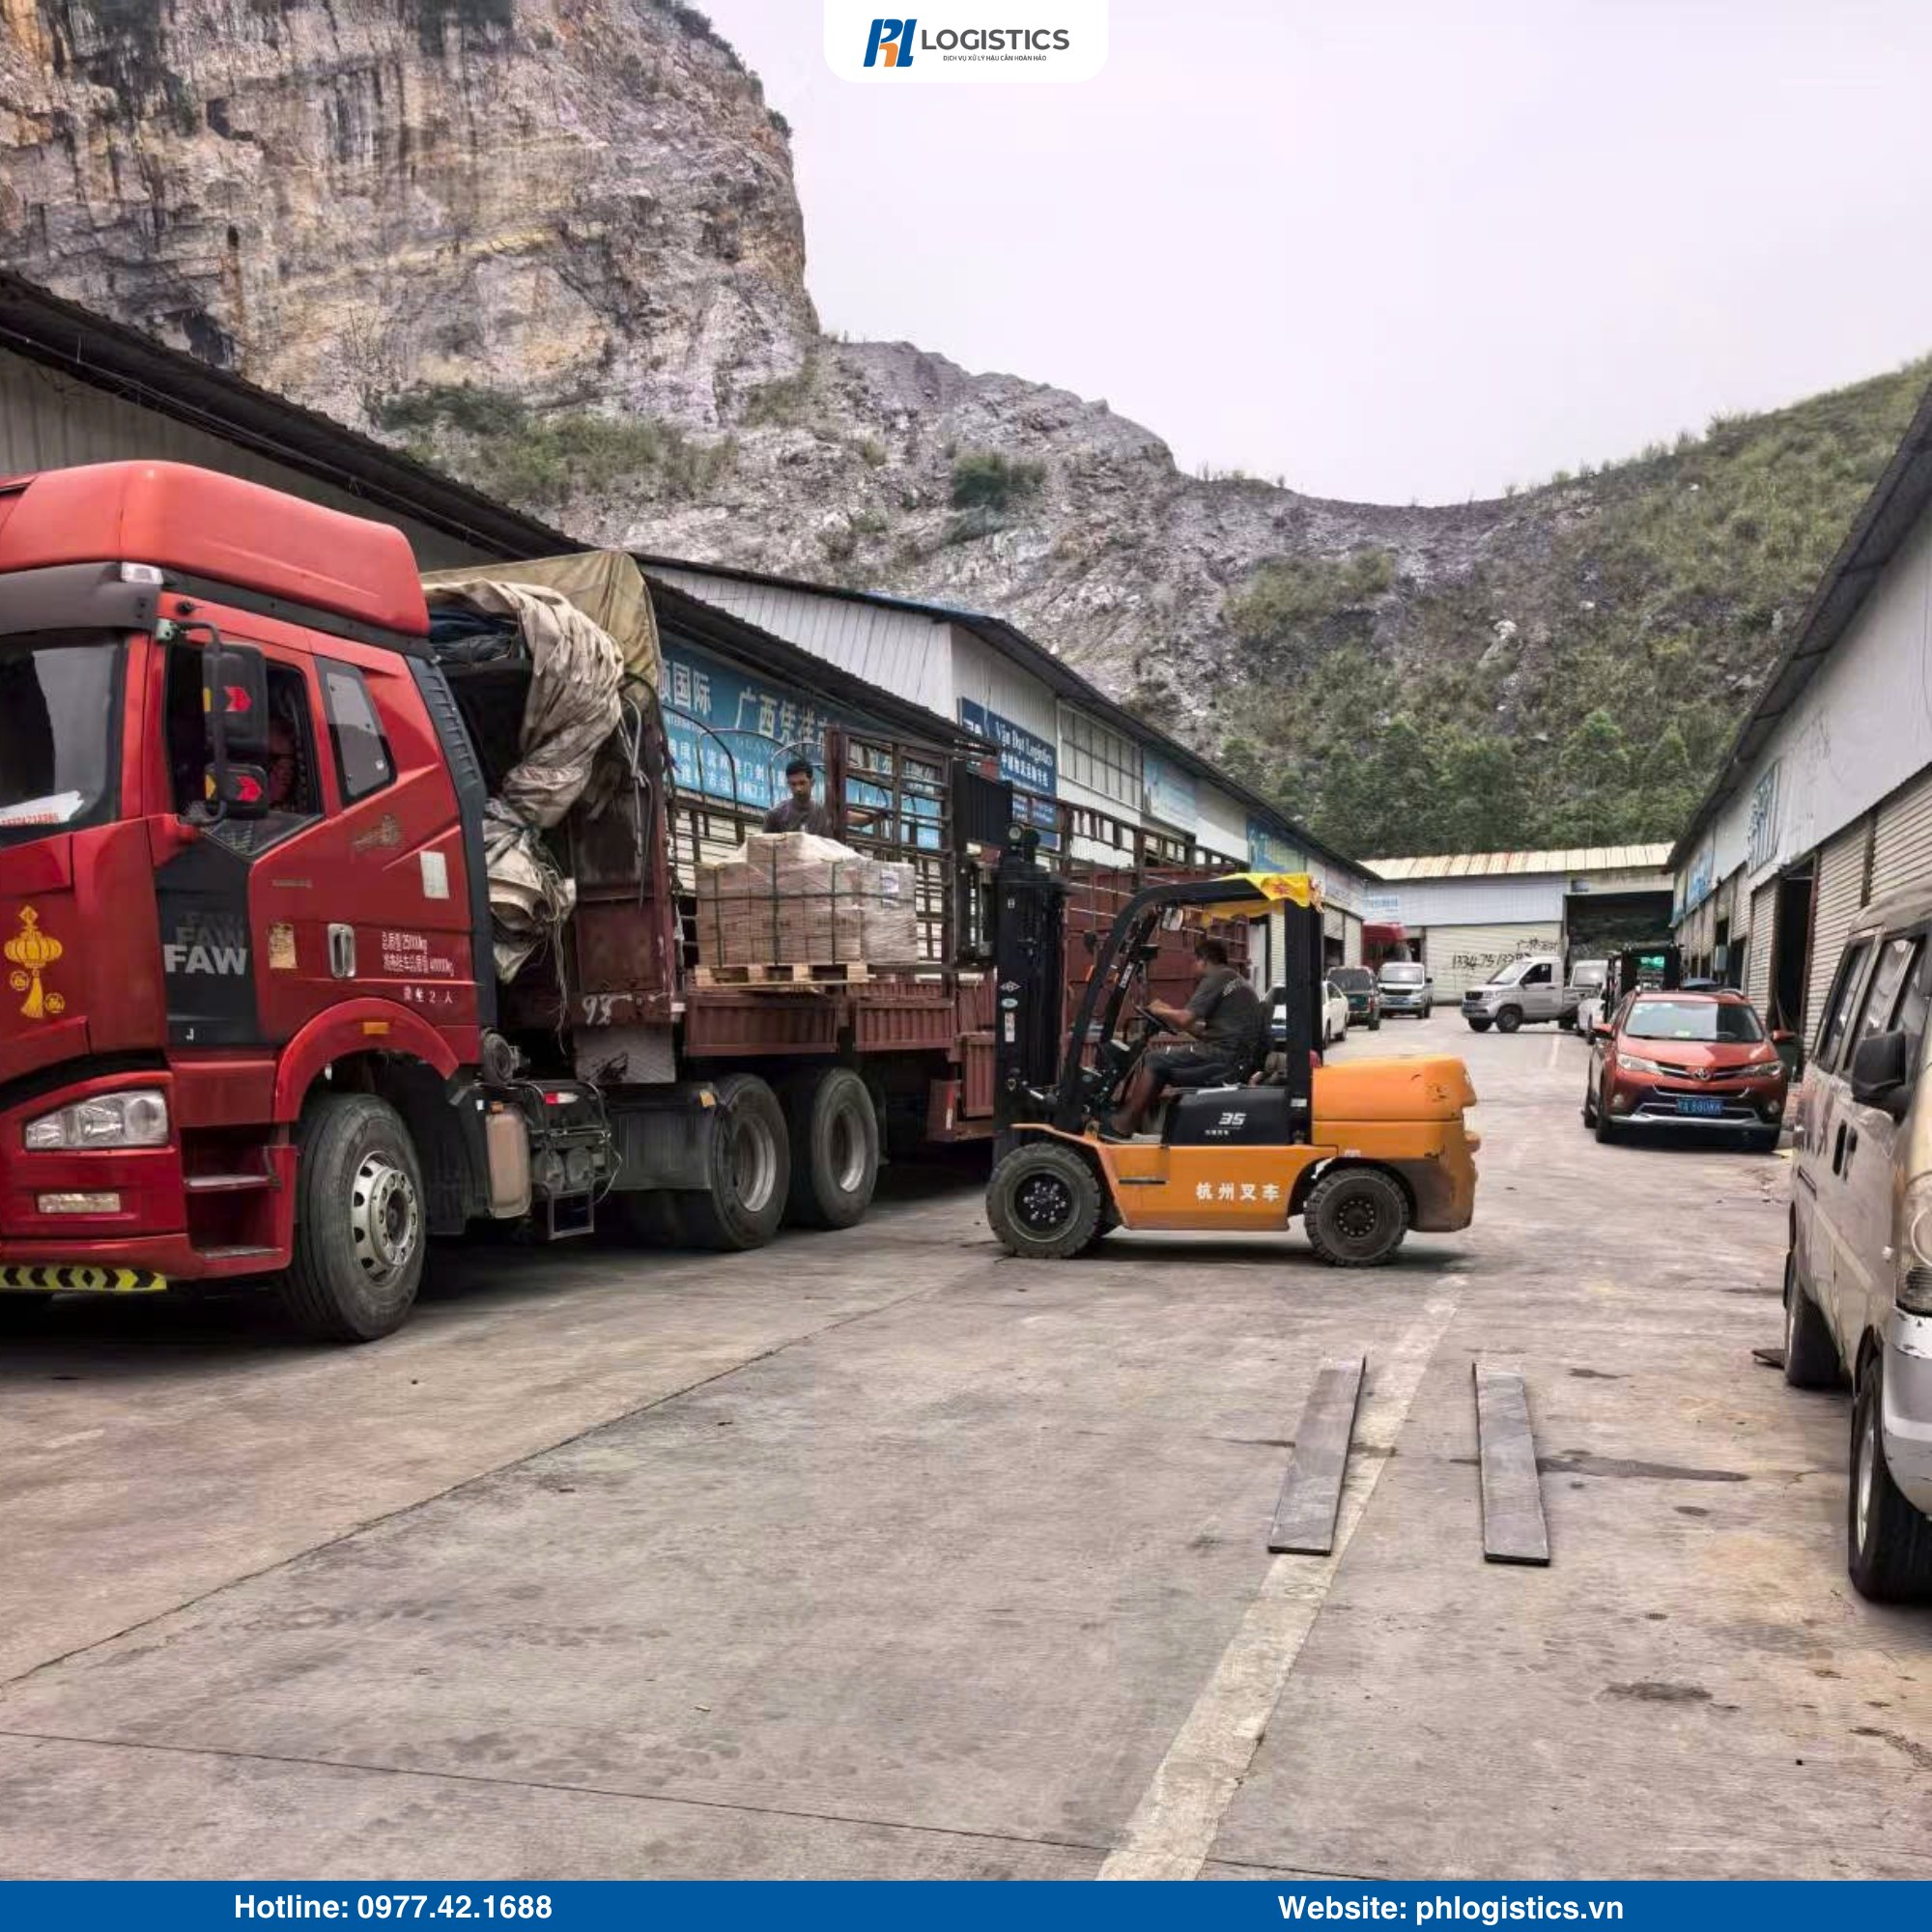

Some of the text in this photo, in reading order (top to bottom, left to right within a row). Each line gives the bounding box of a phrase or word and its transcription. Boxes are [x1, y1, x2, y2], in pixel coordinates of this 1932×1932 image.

[163, 943, 248, 976] FAW
[1218, 1112, 1247, 1126] 35
[1196, 1181, 1280, 1203] 杭州叉车
